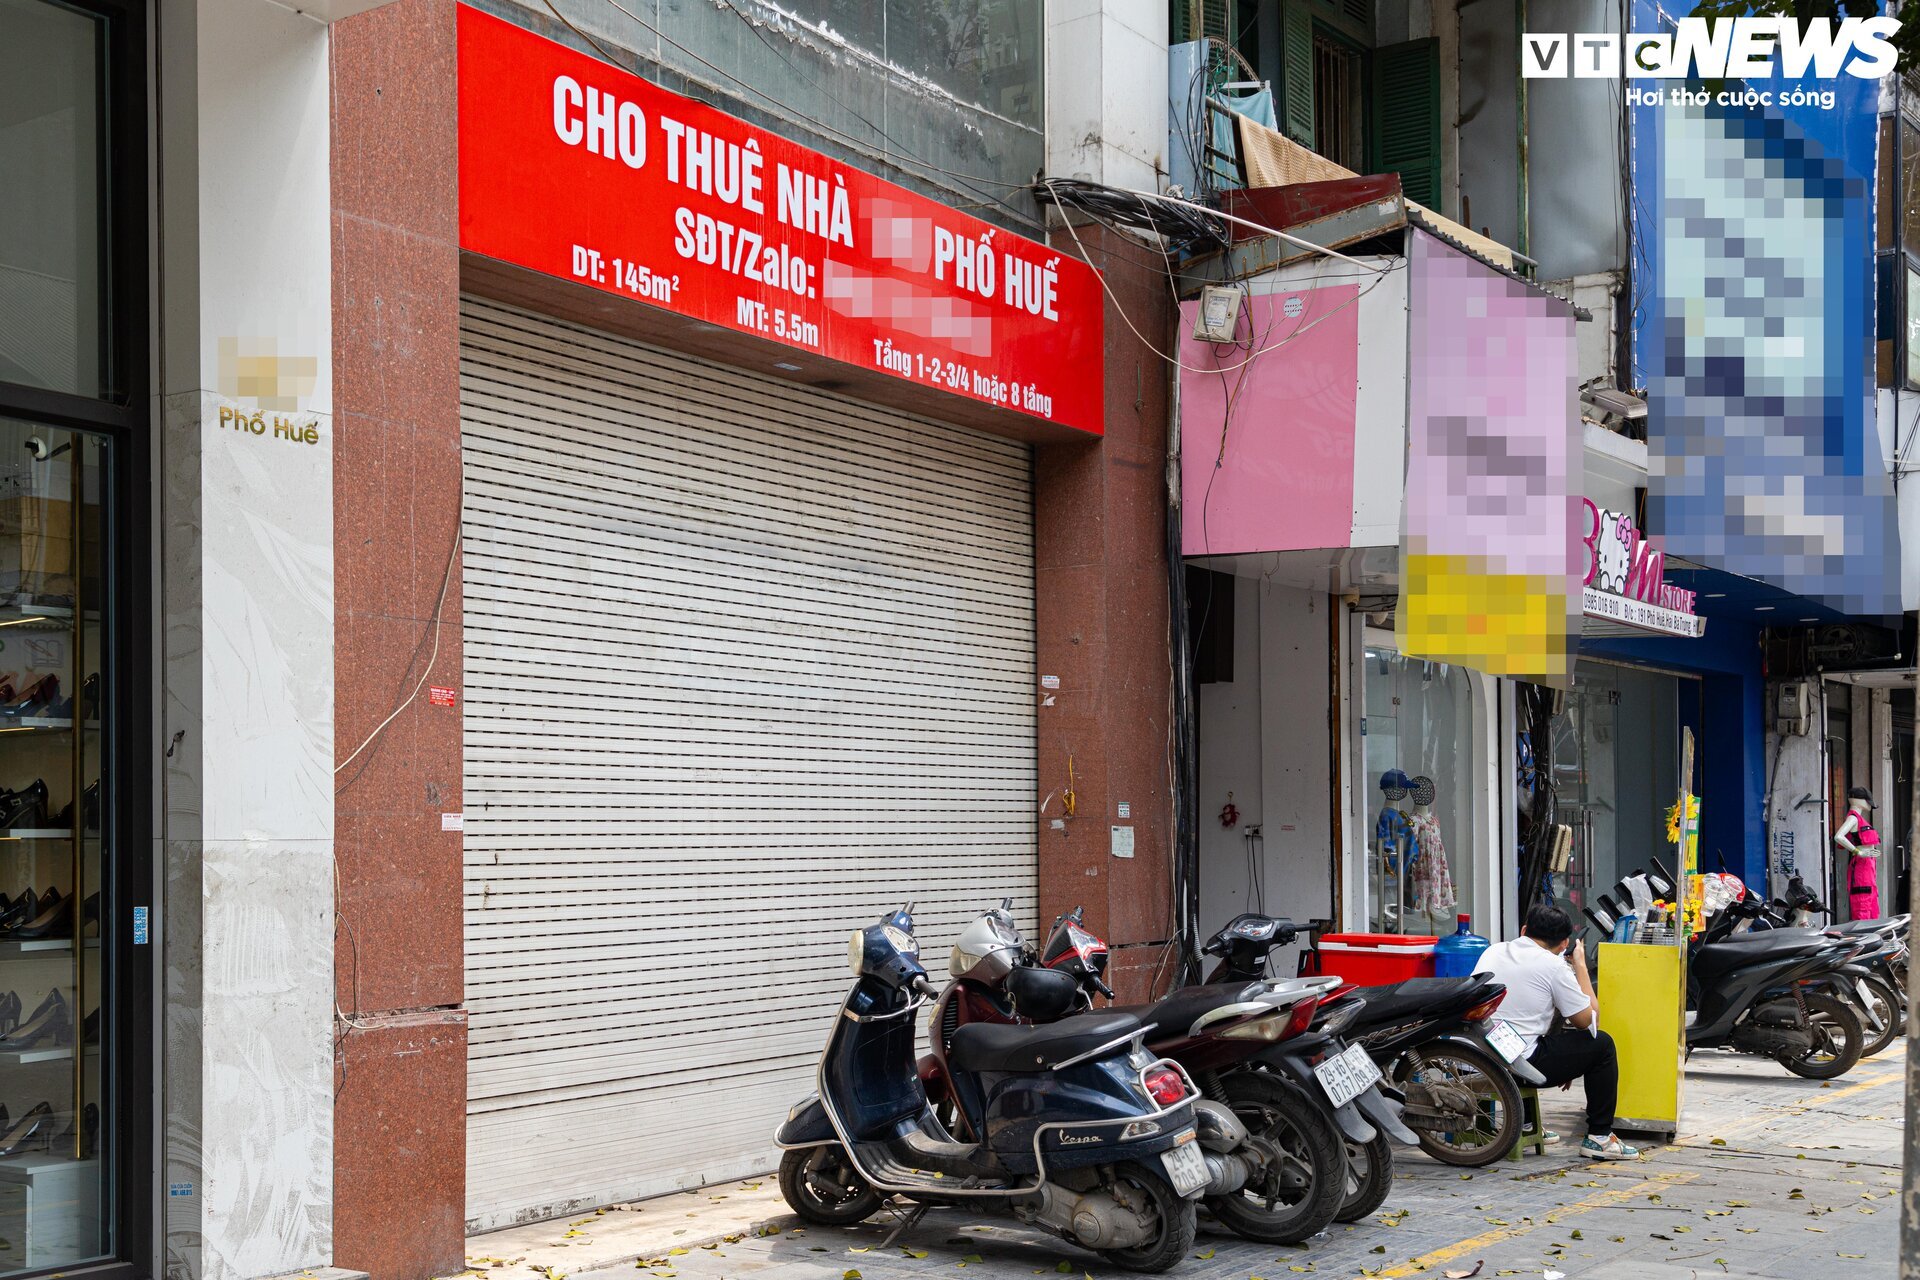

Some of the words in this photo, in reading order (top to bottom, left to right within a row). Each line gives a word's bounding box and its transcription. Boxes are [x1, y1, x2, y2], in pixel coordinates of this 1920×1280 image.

[553, 75, 647, 169] CHO
[660, 115, 764, 215] THUÊ
[777, 162, 854, 247] NHÀ
[934, 226, 996, 298] PHỐ
[1004, 256, 1061, 322] HUẾ
[572, 244, 605, 285] DT:
[674, 206, 816, 298] SĐT/Zalo:
[737, 296, 769, 334] MT:
[774, 308, 819, 348] 5.5m
[873, 338, 912, 378] Tầng
[916, 353, 970, 392] 1-2-3/4
[973, 369, 1008, 406] hoặc
[1011, 382, 1020, 406] 8
[1022, 383, 1052, 418] tầng
[219, 405, 267, 436] Phố
[273, 416, 320, 445] Huế
[1662, 584, 1697, 616] STORE
[1330, 1075, 1357, 1103] 0767
[1059, 1128, 1104, 1146] Vespa
